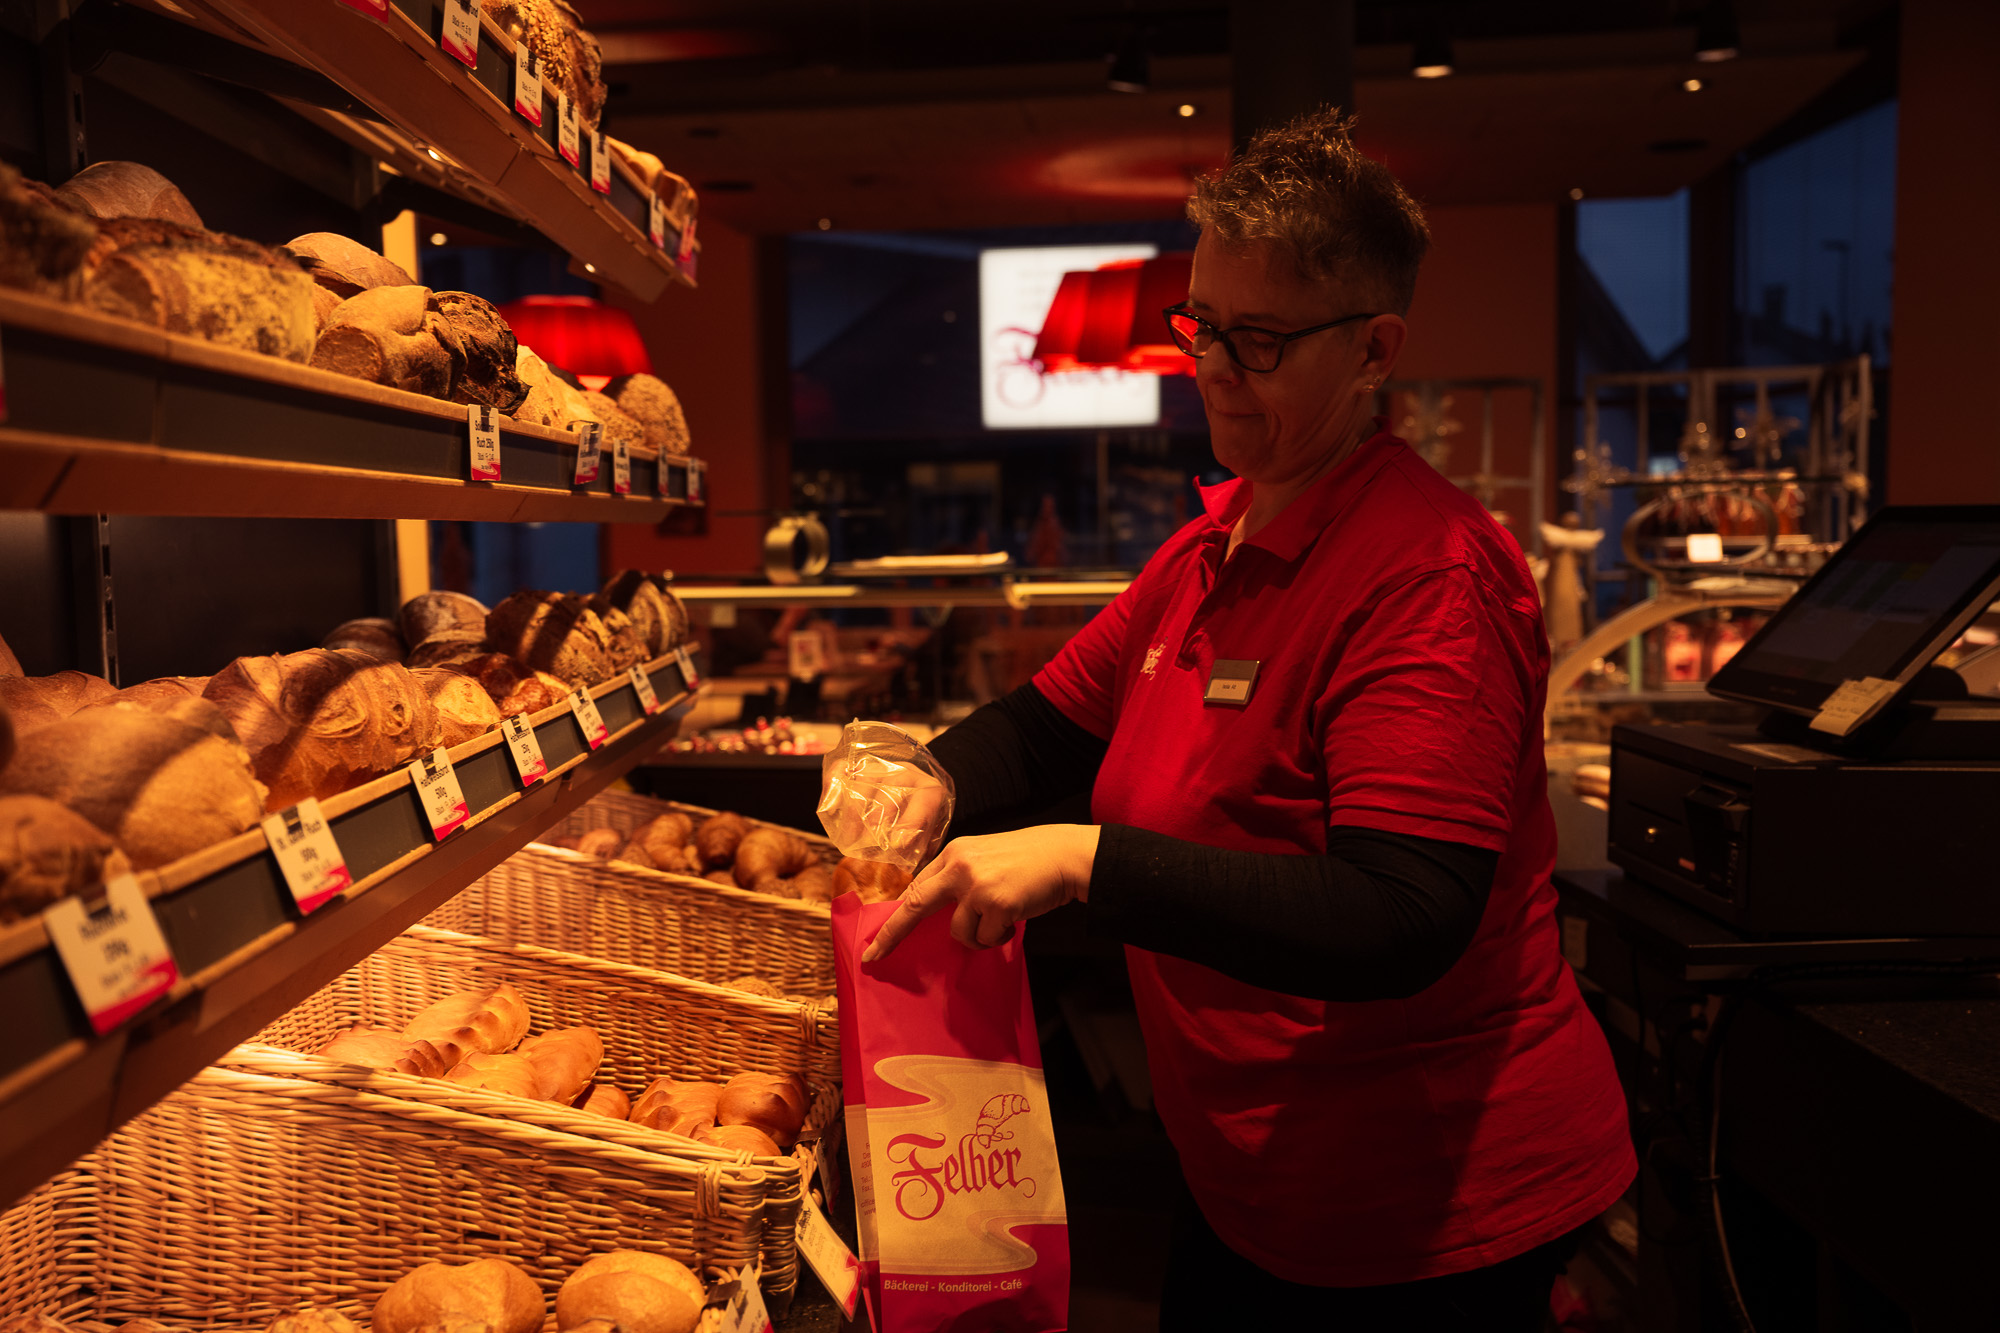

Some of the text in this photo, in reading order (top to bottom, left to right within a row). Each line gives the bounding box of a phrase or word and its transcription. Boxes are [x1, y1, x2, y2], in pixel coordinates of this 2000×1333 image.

[887, 1132, 1036, 1221] Felber
[884, 1280, 929, 1291] Bäckerei
[938, 1282, 992, 1292] Konditorei
[1000, 1279, 1022, 1291] Café
